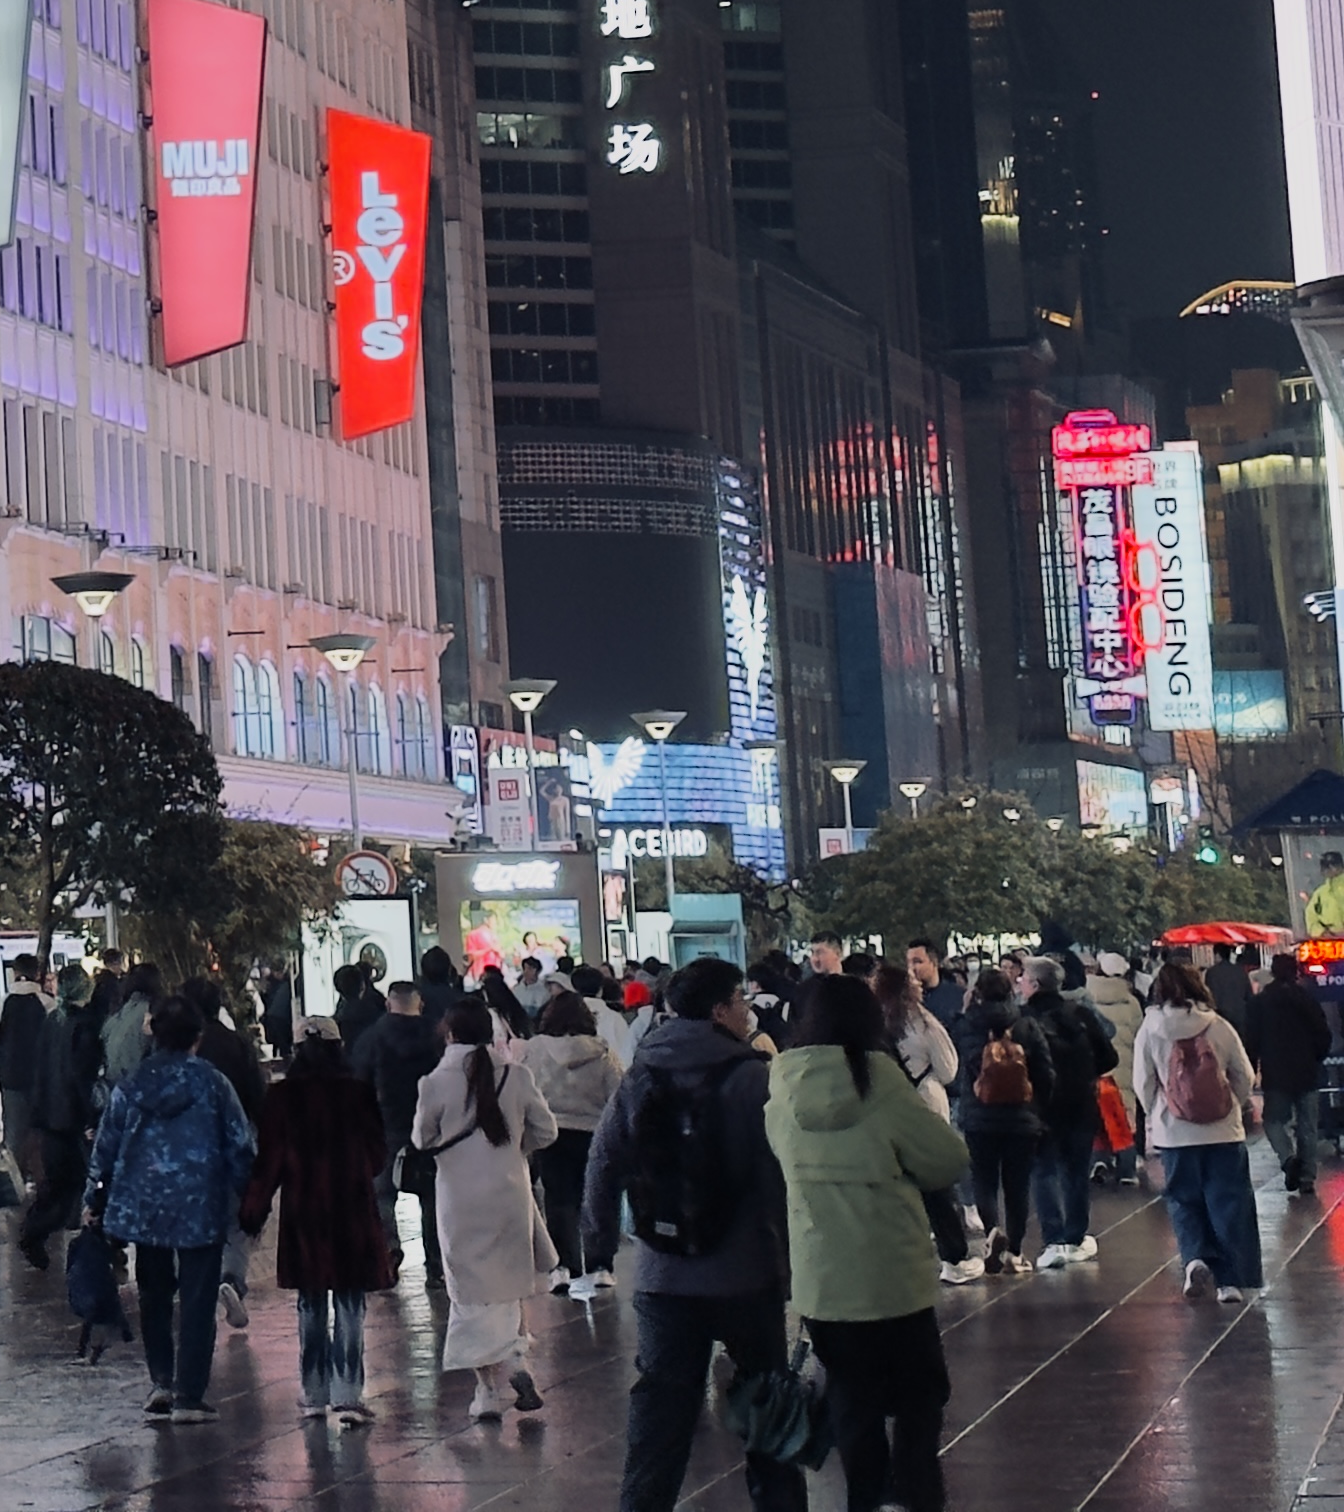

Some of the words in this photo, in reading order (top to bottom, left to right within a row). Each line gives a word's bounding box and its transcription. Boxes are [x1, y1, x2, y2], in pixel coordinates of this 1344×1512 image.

[162, 139, 249, 178] MUJI
[1154, 497, 1192, 696] BOSIDENG
[598, 828, 708, 859] ACEBIRD
